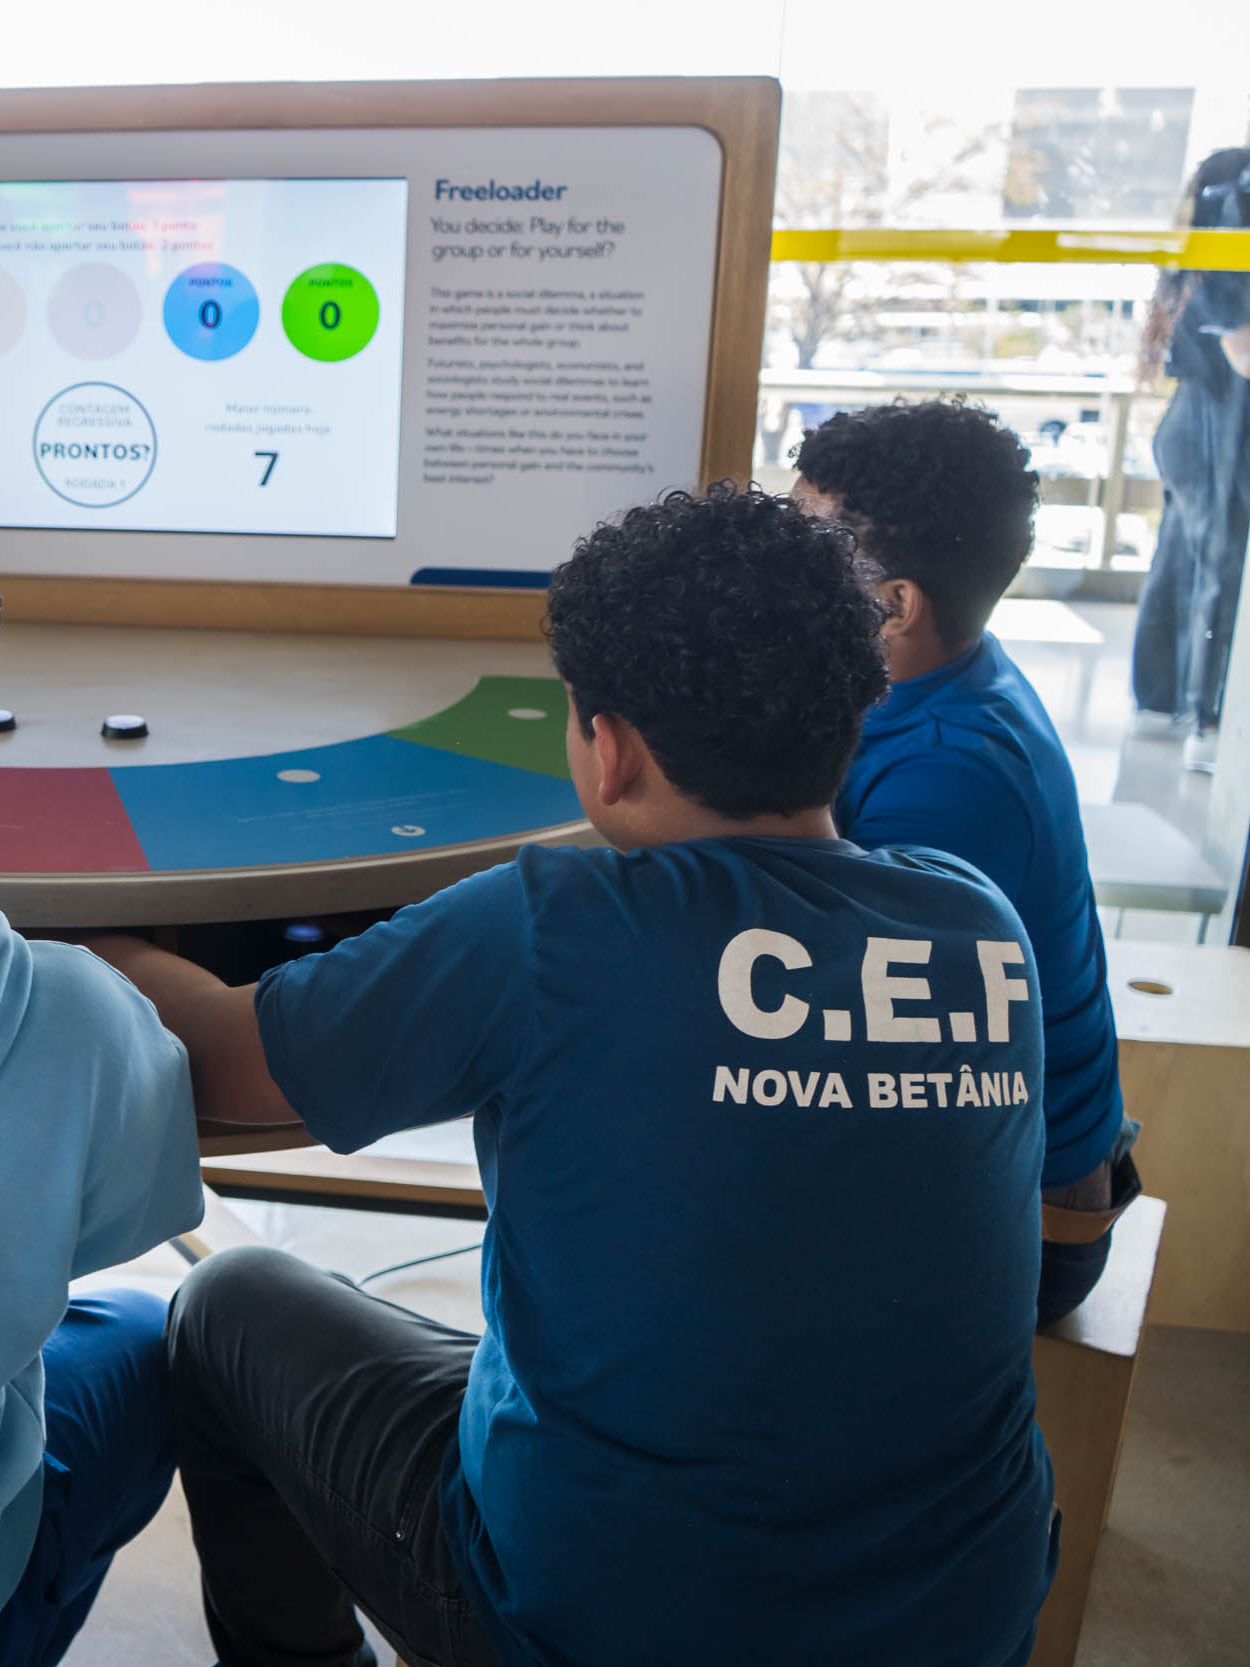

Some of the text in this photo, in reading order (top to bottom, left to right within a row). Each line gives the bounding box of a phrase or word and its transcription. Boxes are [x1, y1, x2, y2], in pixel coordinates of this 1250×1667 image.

[435, 179, 567, 201] Freeloader
[431, 217, 461, 233] You
[530, 217, 563, 236] Play
[568, 217, 590, 233] for
[597, 219, 625, 233] the
[432, 241, 615, 261] group or for yourself?
[85, 300, 104, 328] 0
[199, 299, 222, 330] 0
[319, 300, 342, 330] 0
[40, 443, 150, 460] PRONTOS?
[254, 452, 278, 486] 7
[718, 928, 1029, 1042] C.E.F
[712, 1064, 1028, 1109] NOVA BETÂNIA
